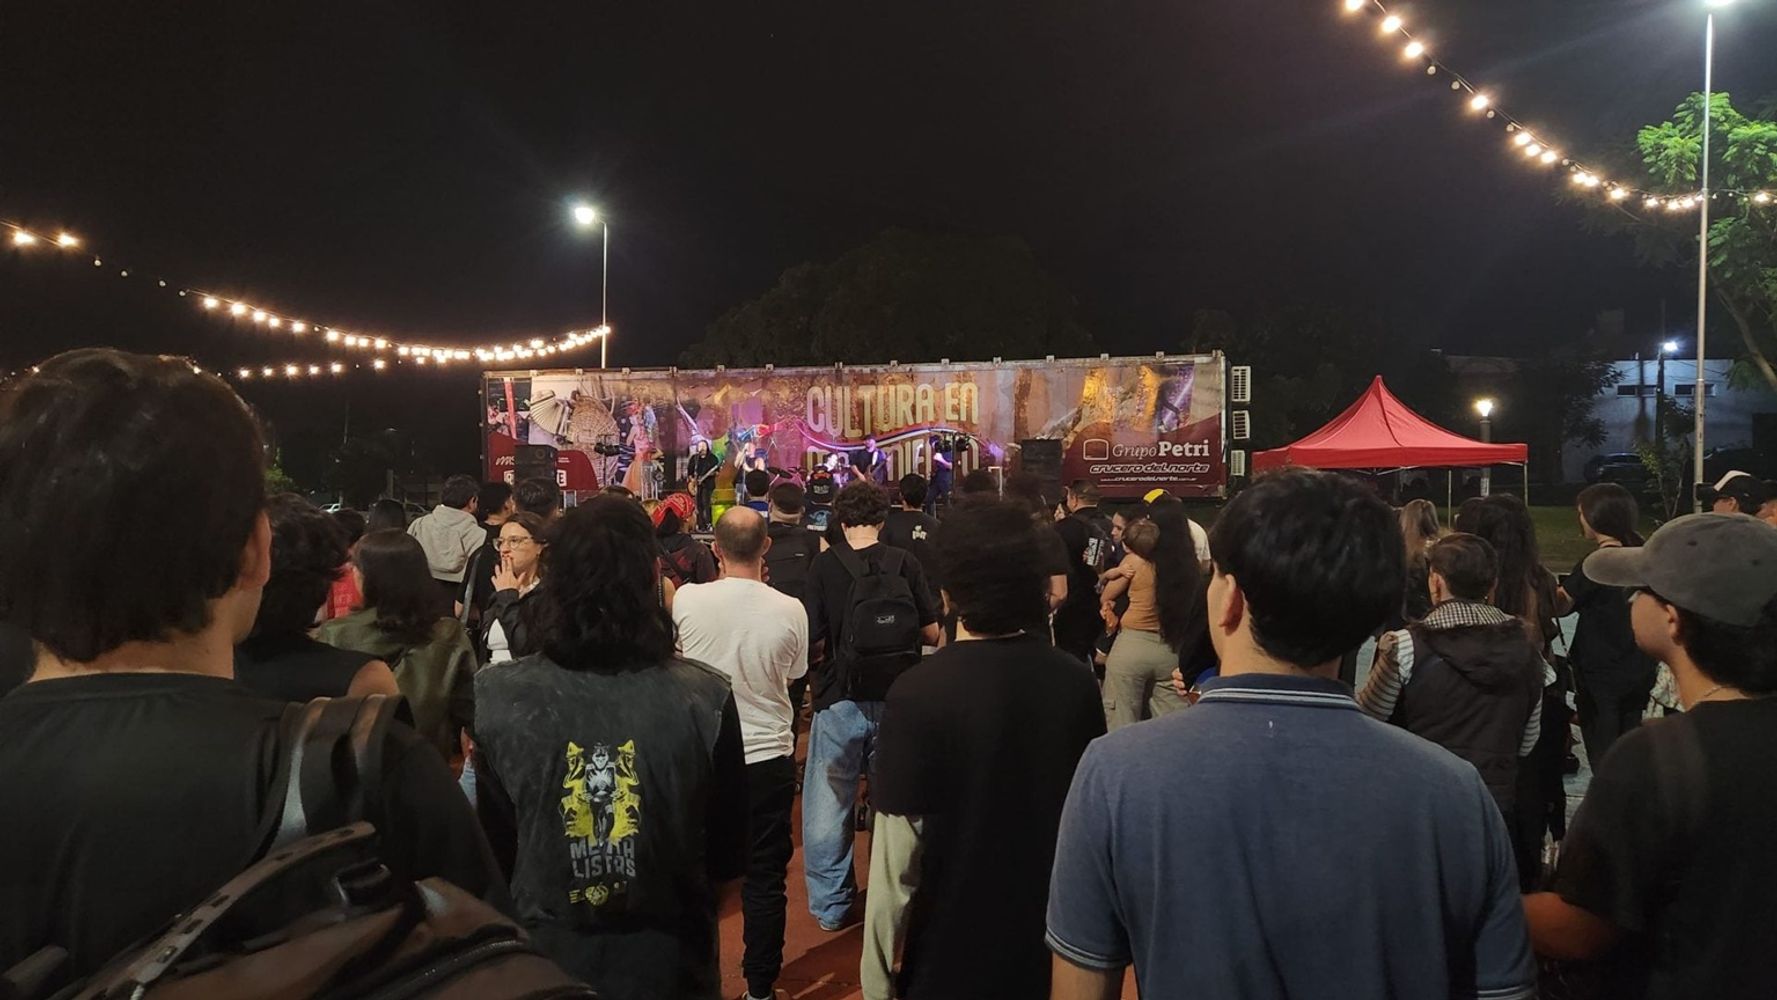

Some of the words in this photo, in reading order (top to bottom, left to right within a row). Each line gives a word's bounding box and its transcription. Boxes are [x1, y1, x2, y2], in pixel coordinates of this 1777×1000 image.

[806, 383, 935, 438] CULTURA
[945, 381, 979, 425] EN
[1112, 443, 1158, 460] Grupo
[1158, 439, 1210, 457] Petri
